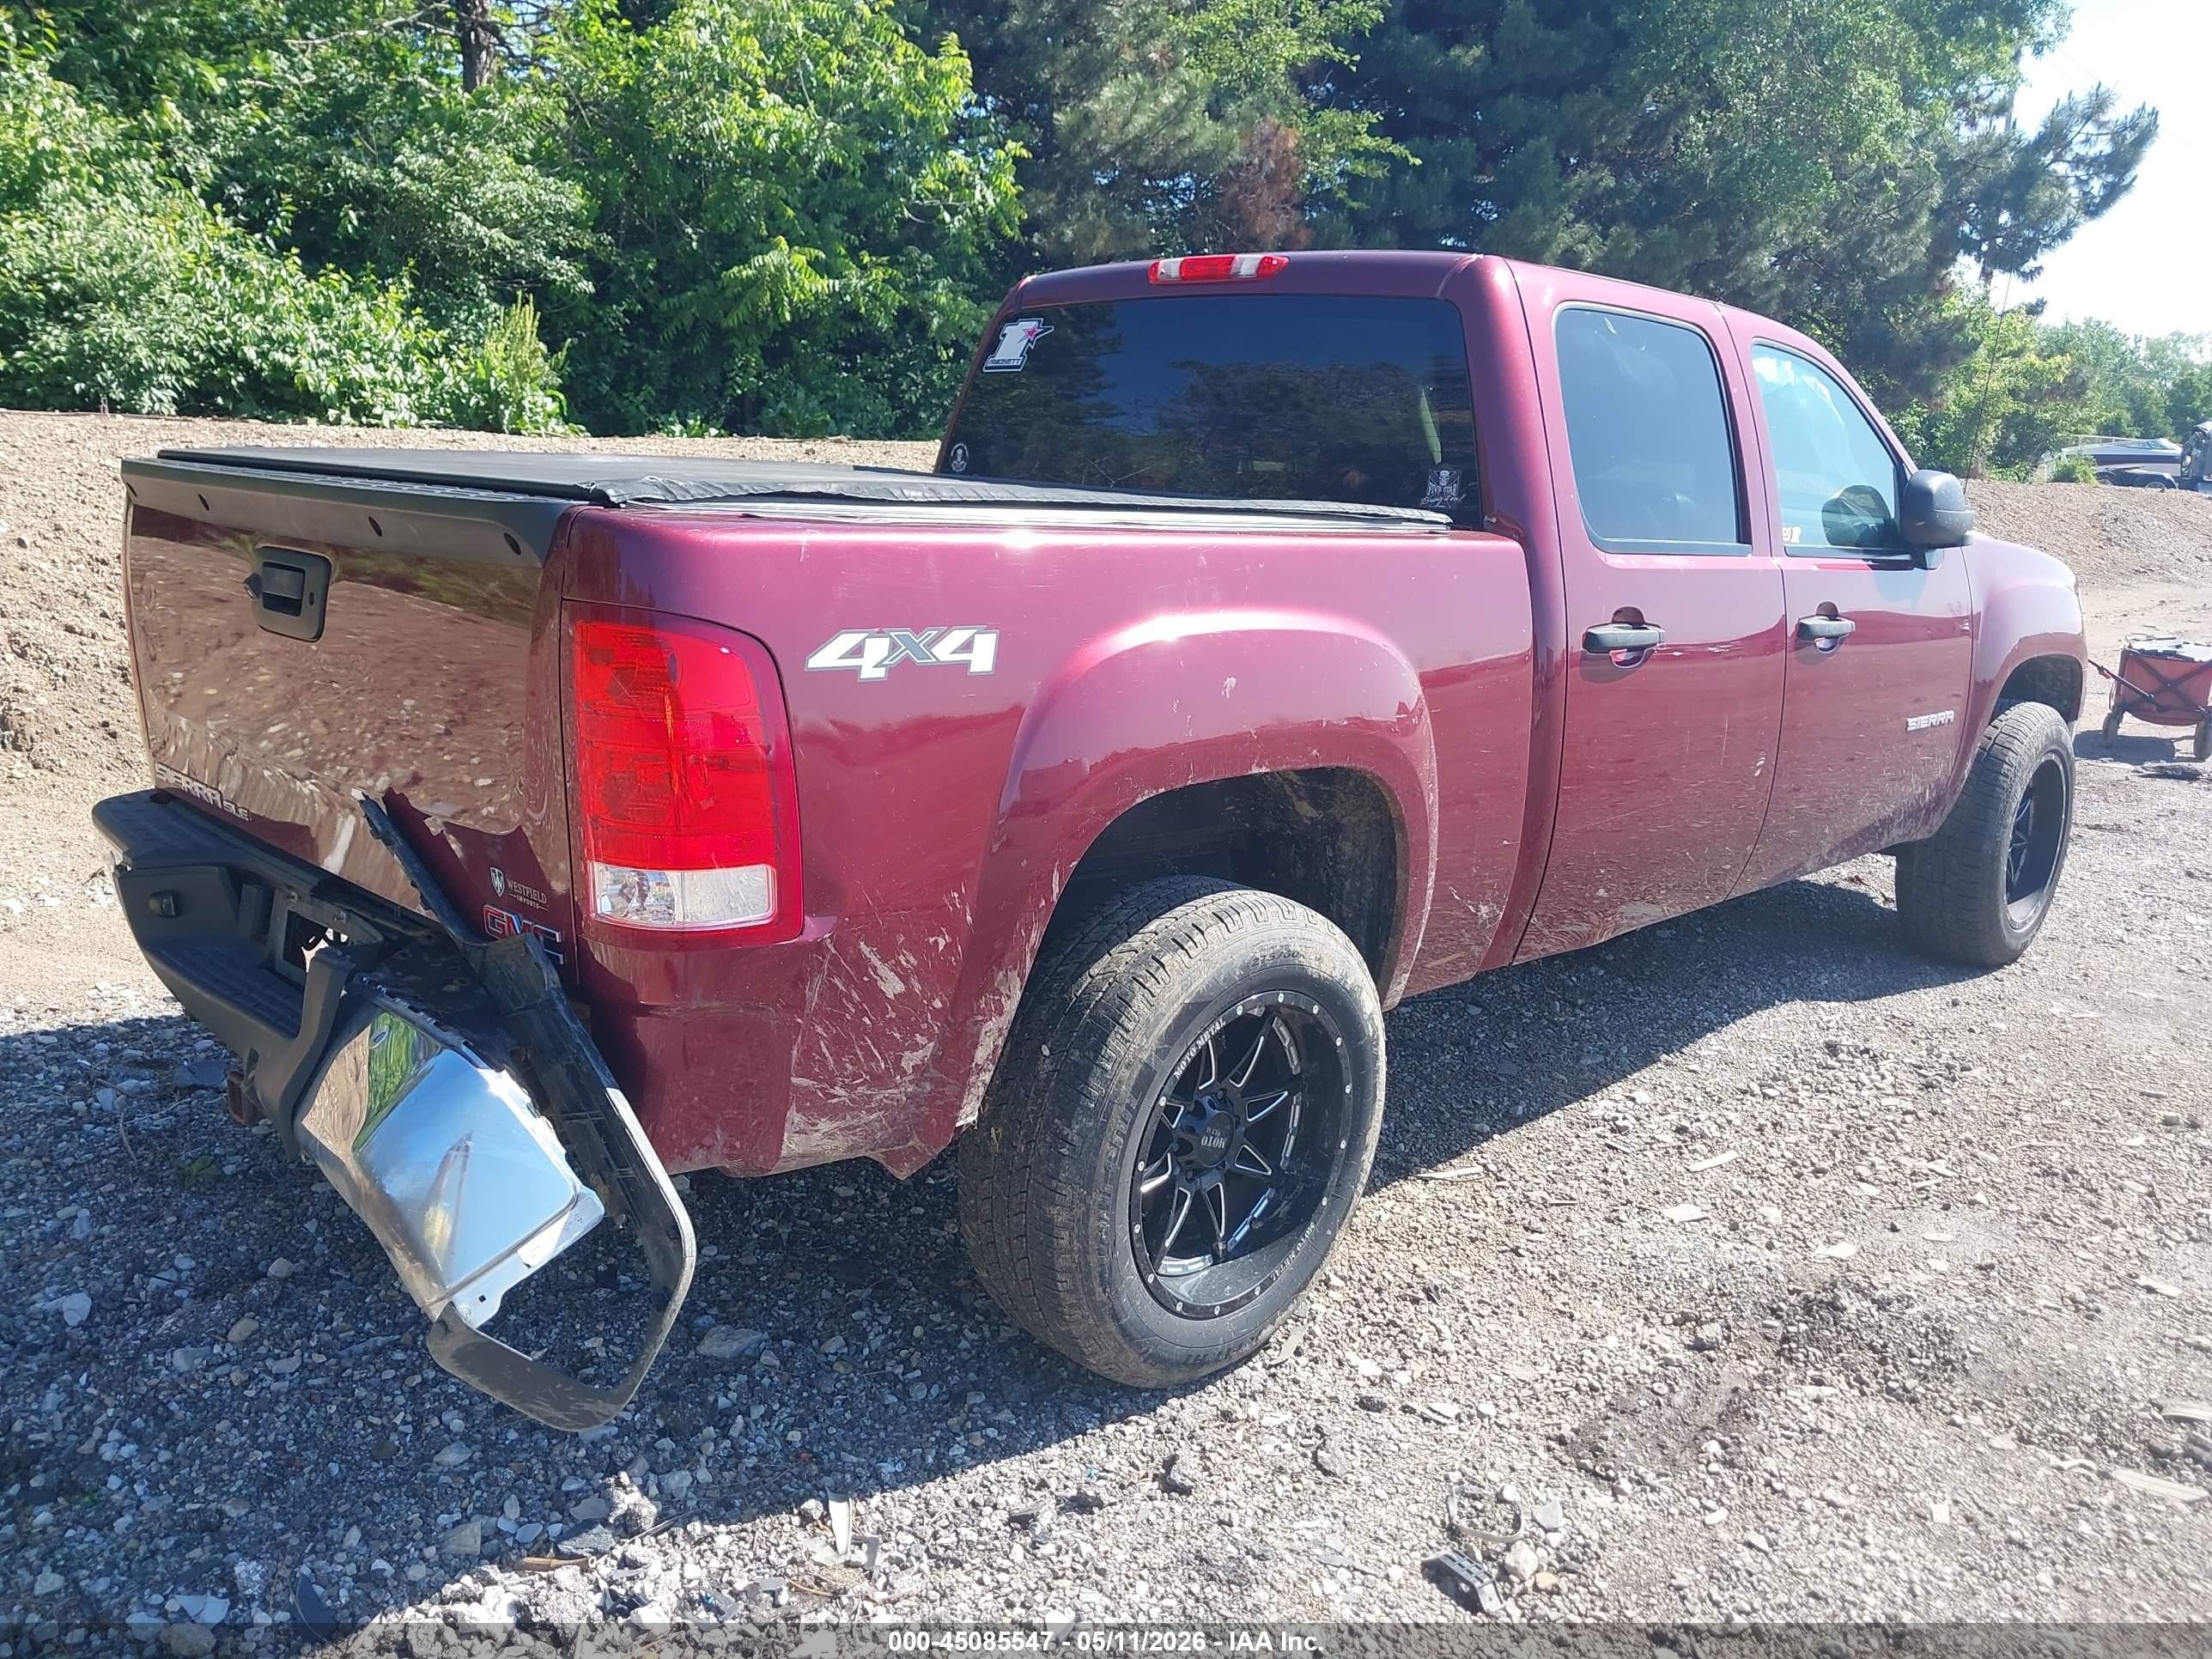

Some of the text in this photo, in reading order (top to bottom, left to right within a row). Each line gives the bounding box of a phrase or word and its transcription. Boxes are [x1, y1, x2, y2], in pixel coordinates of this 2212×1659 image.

[1443, 483, 1457, 497] STAR
[1906, 710, 1955, 732] SIERRA
[155, 762, 249, 822] SIERRA SLE
[507, 878, 547, 904] WESTFIELD
[516, 895, 539, 909] IMPORTS
[1173, 1018, 1226, 1080] MOTO METAL
